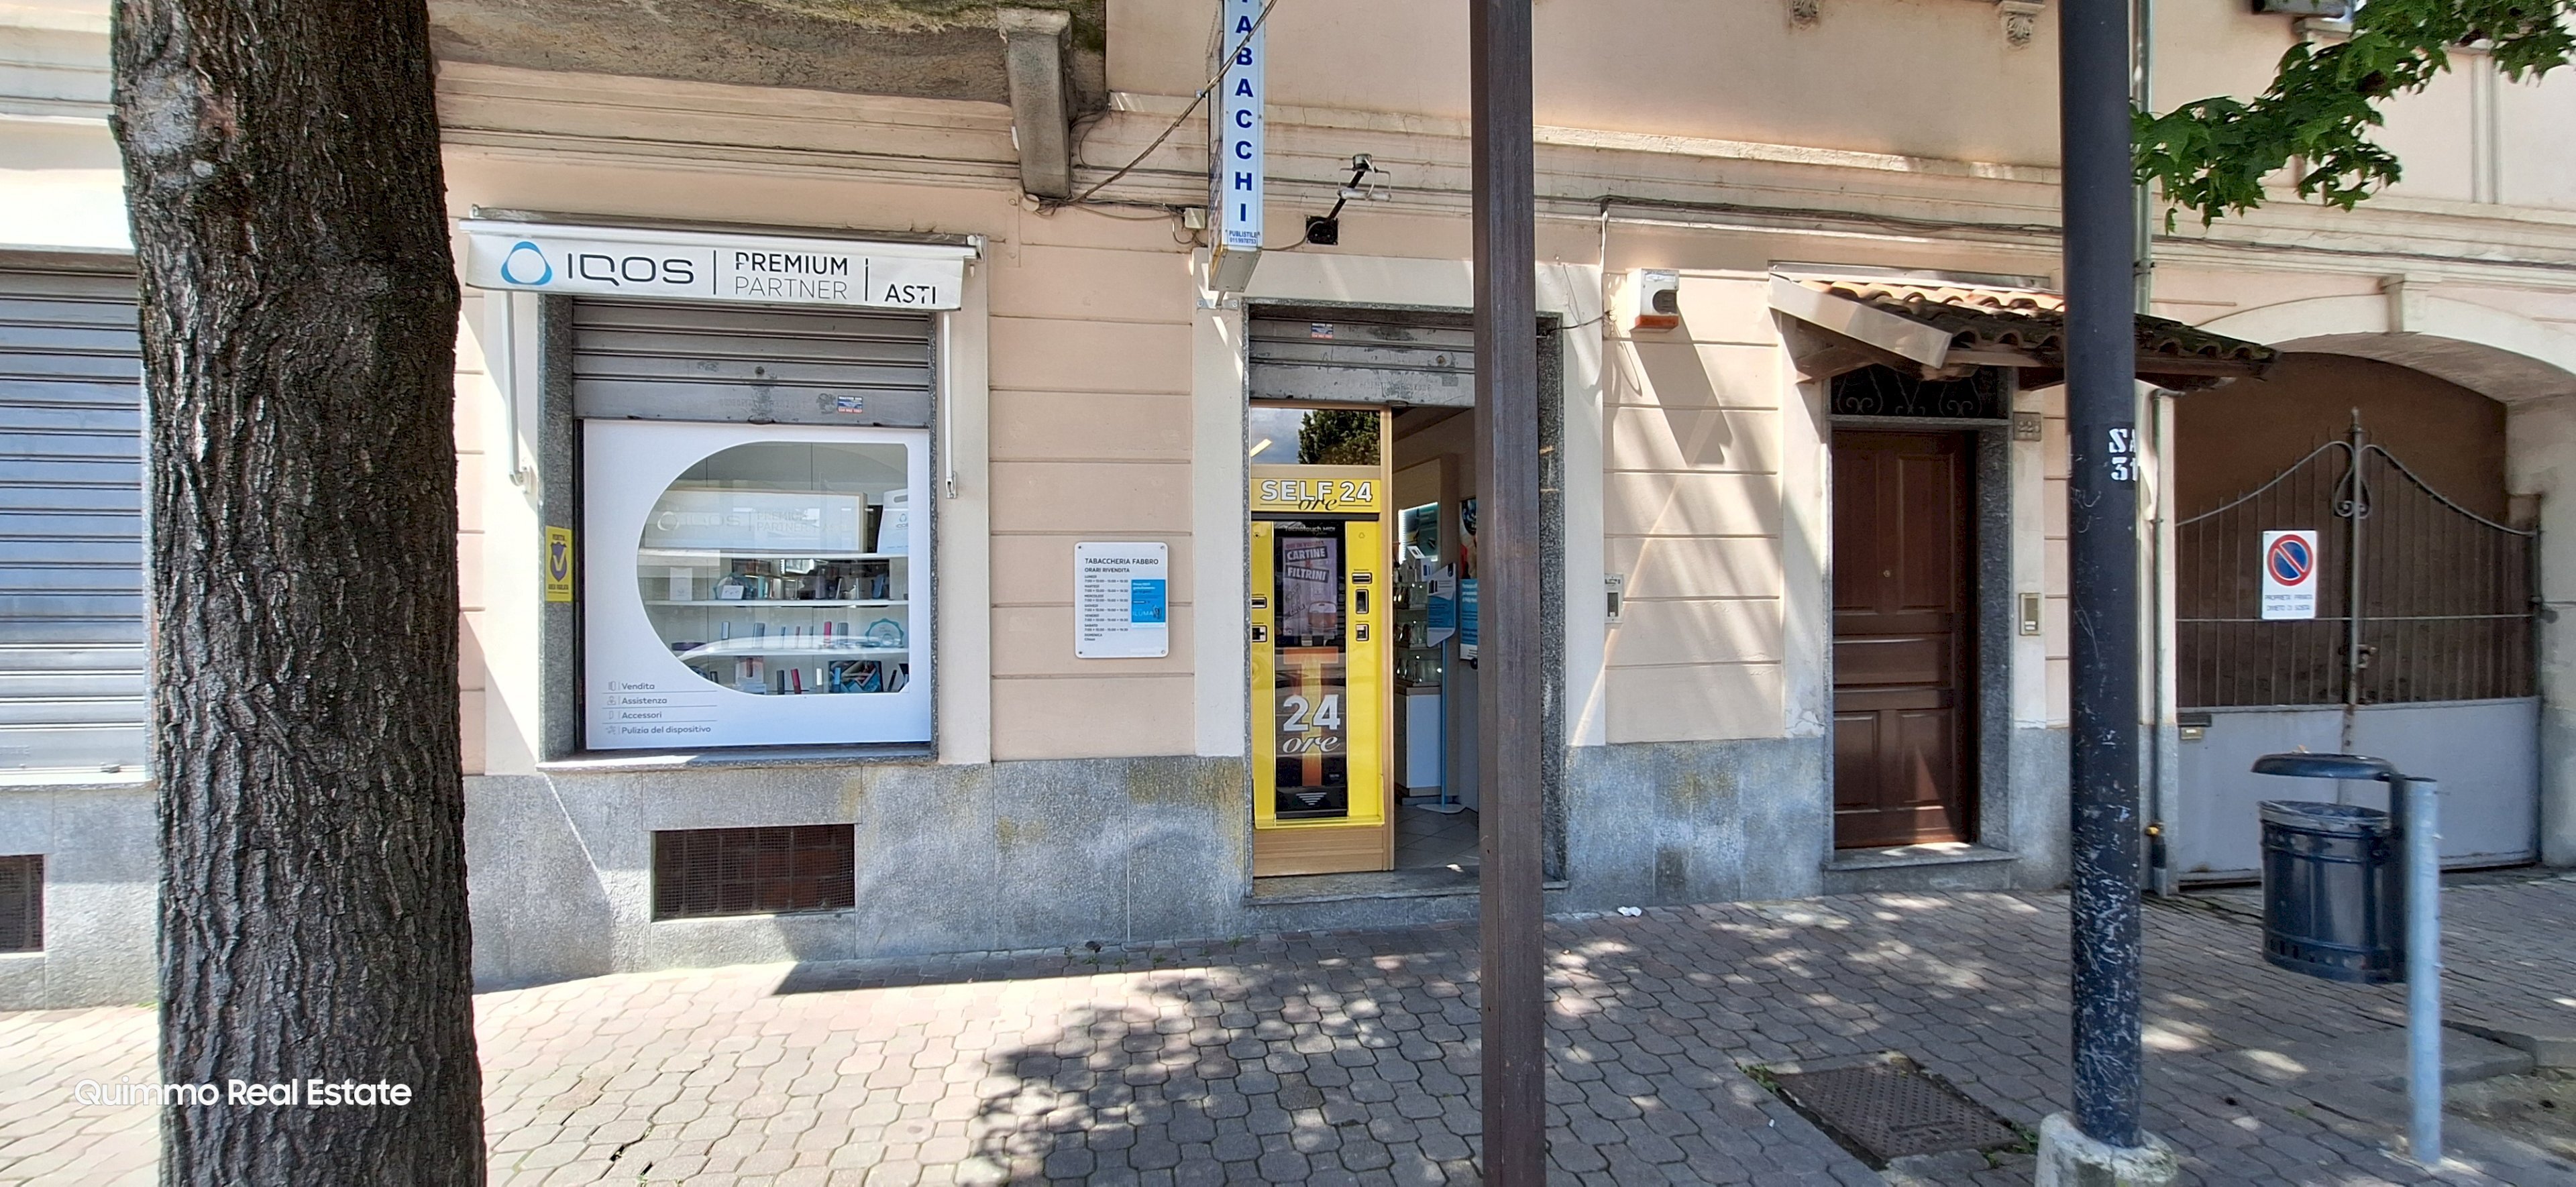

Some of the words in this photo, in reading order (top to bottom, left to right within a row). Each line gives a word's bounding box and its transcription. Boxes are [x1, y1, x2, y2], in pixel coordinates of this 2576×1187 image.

[1235, 0, 1254, 222] ABACCHI
[568, 253, 694, 287] IQOS
[735, 251, 848, 276] PREMIUM
[735, 276, 848, 300] PARTNER
[884, 284, 936, 304] ASTI
[1260, 480, 1334, 502] SELF
[1340, 481, 1373, 503] 24
[1298, 498, 1340, 512] ore
[1287, 547, 1326, 561] CARTINE
[1287, 567, 1326, 581] FILTRINI
[621, 682, 655, 690] Vendita
[621, 697, 667, 705] Assistenza
[621, 711, 662, 720] Accessori
[1283, 693, 1340, 732] 24
[621, 726, 649, 734] Pulizia
[651, 726, 664, 734] del
[665, 725, 711, 736] dispositivo
[1282, 736, 1341, 754] ore
